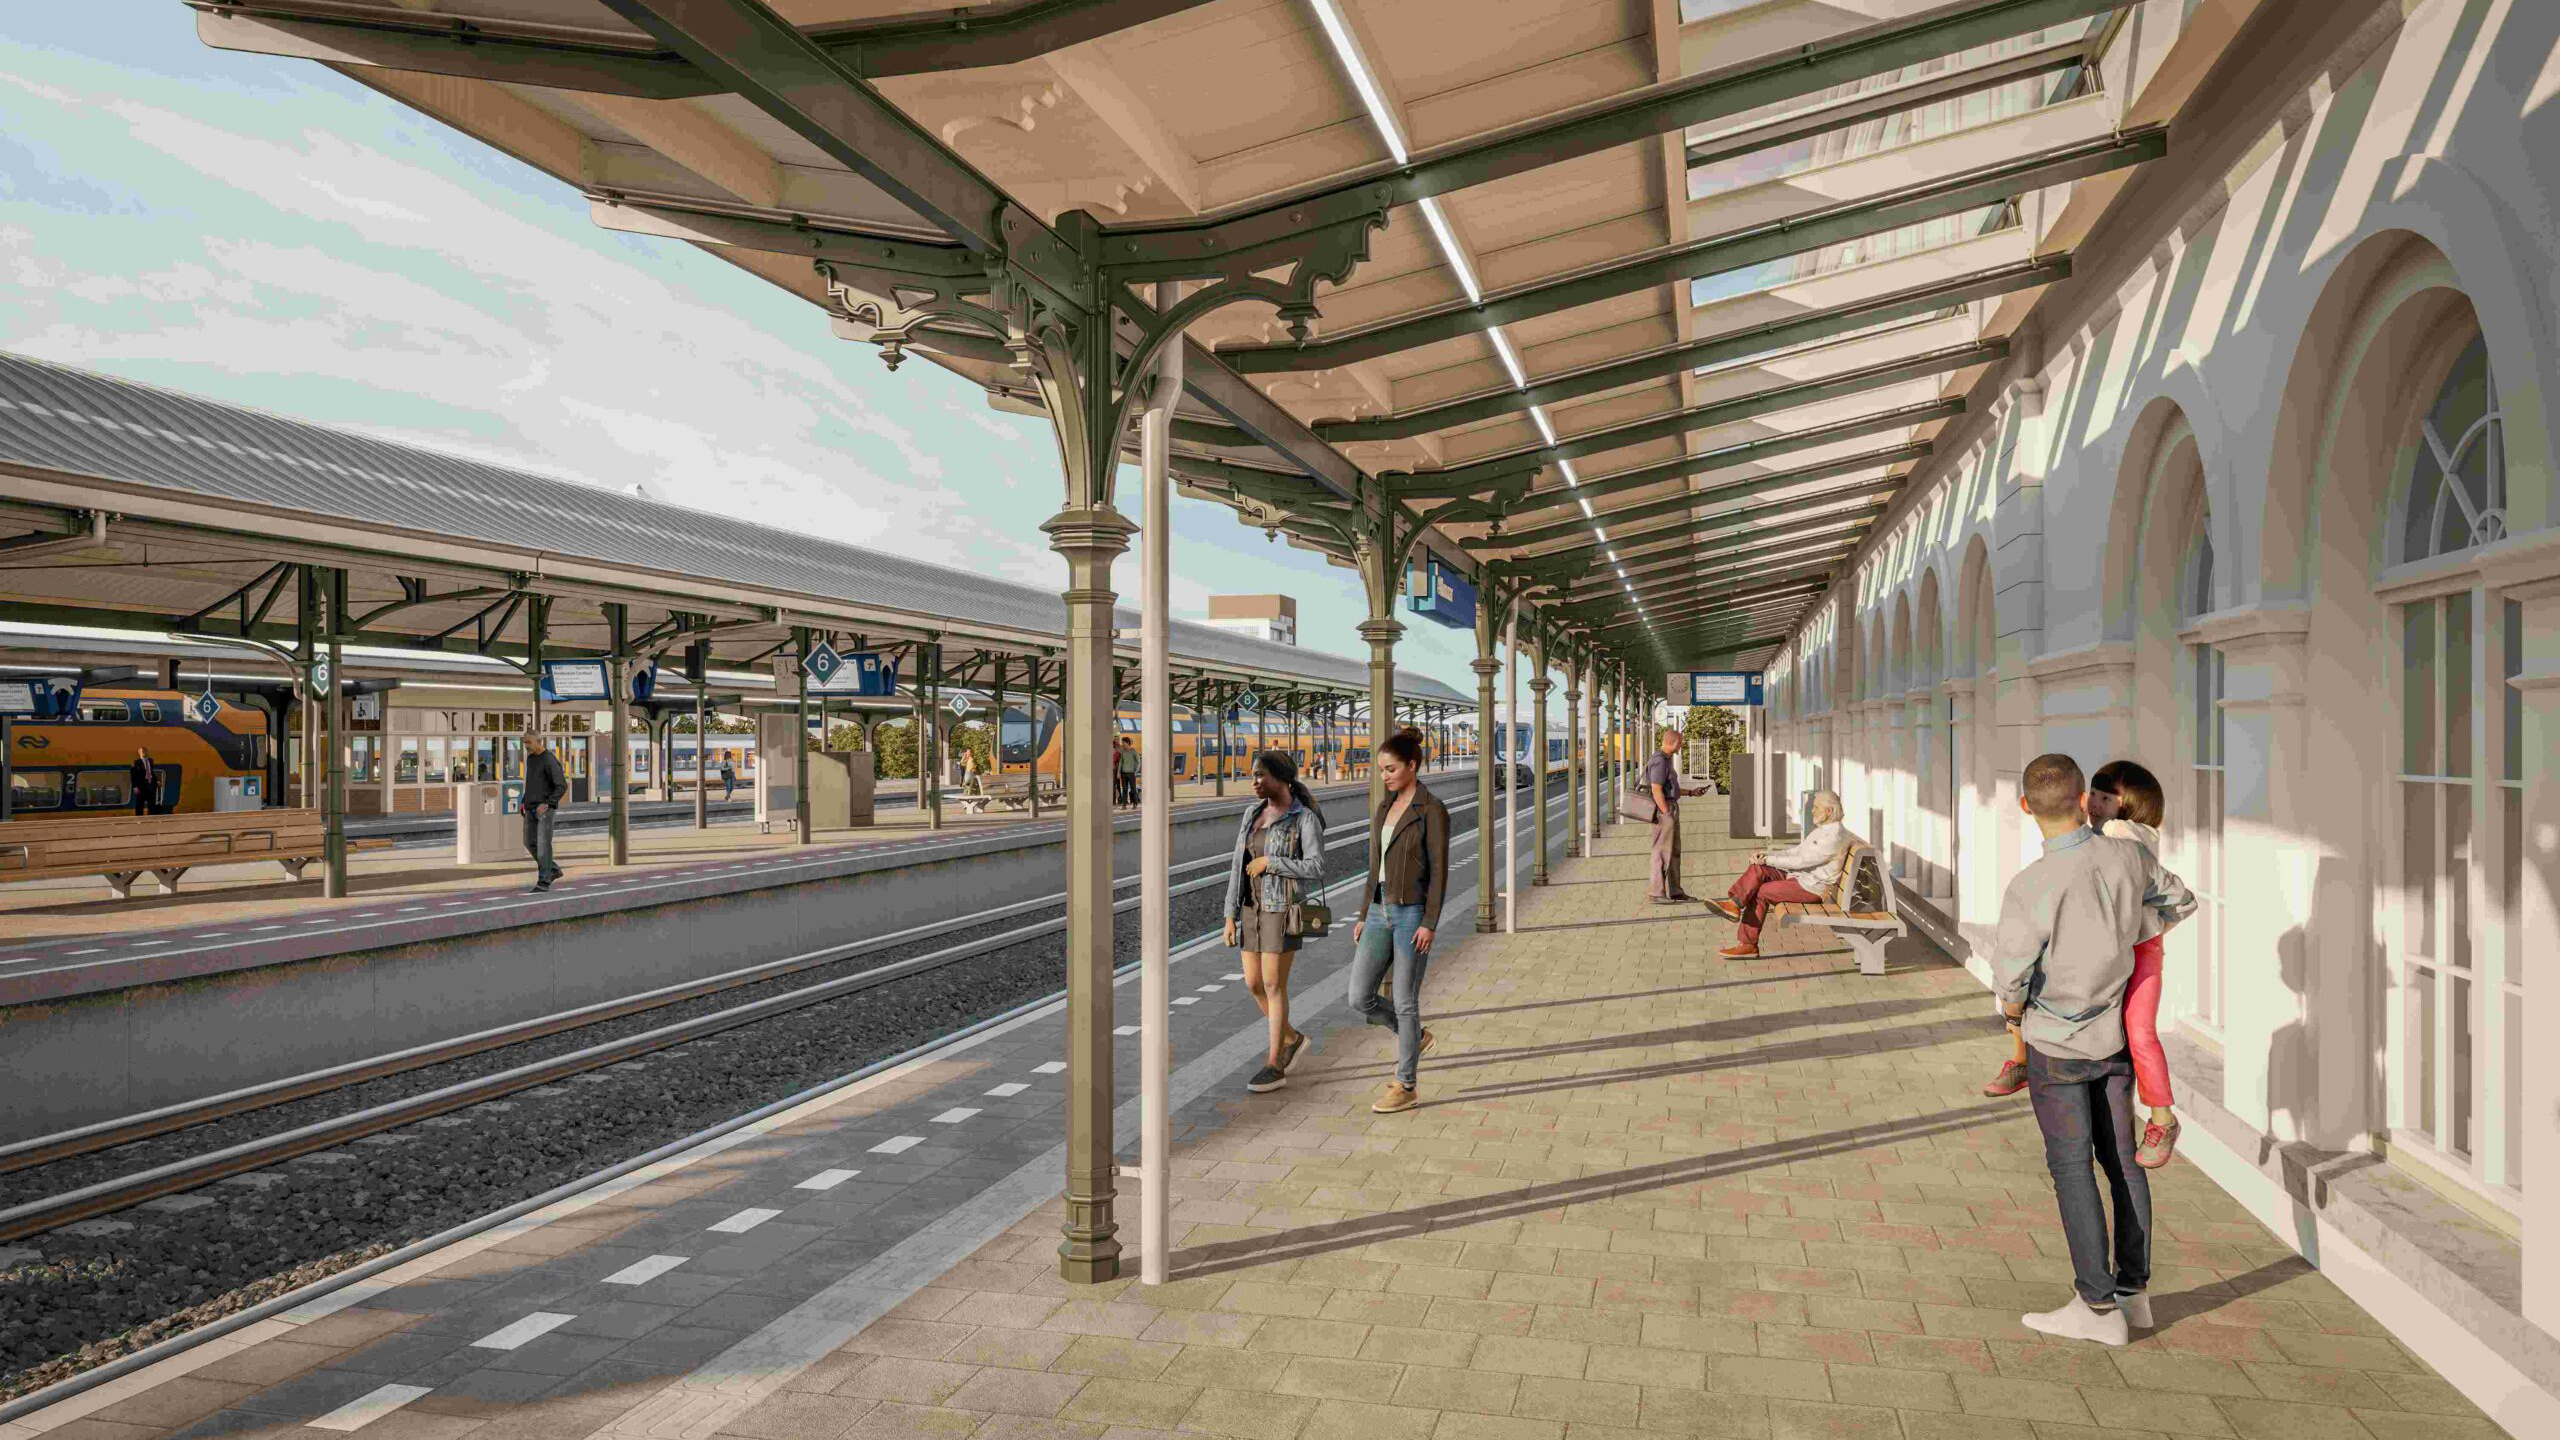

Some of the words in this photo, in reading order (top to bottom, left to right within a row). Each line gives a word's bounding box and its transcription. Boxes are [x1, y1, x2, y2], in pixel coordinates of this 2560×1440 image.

[817, 653, 830, 672] 6
[318, 663, 328, 681] 6
[956, 699, 963, 710] 8
[1244, 694, 1251, 705] 8
[203, 700, 211, 713] 6
[66, 773, 75, 784] 2
